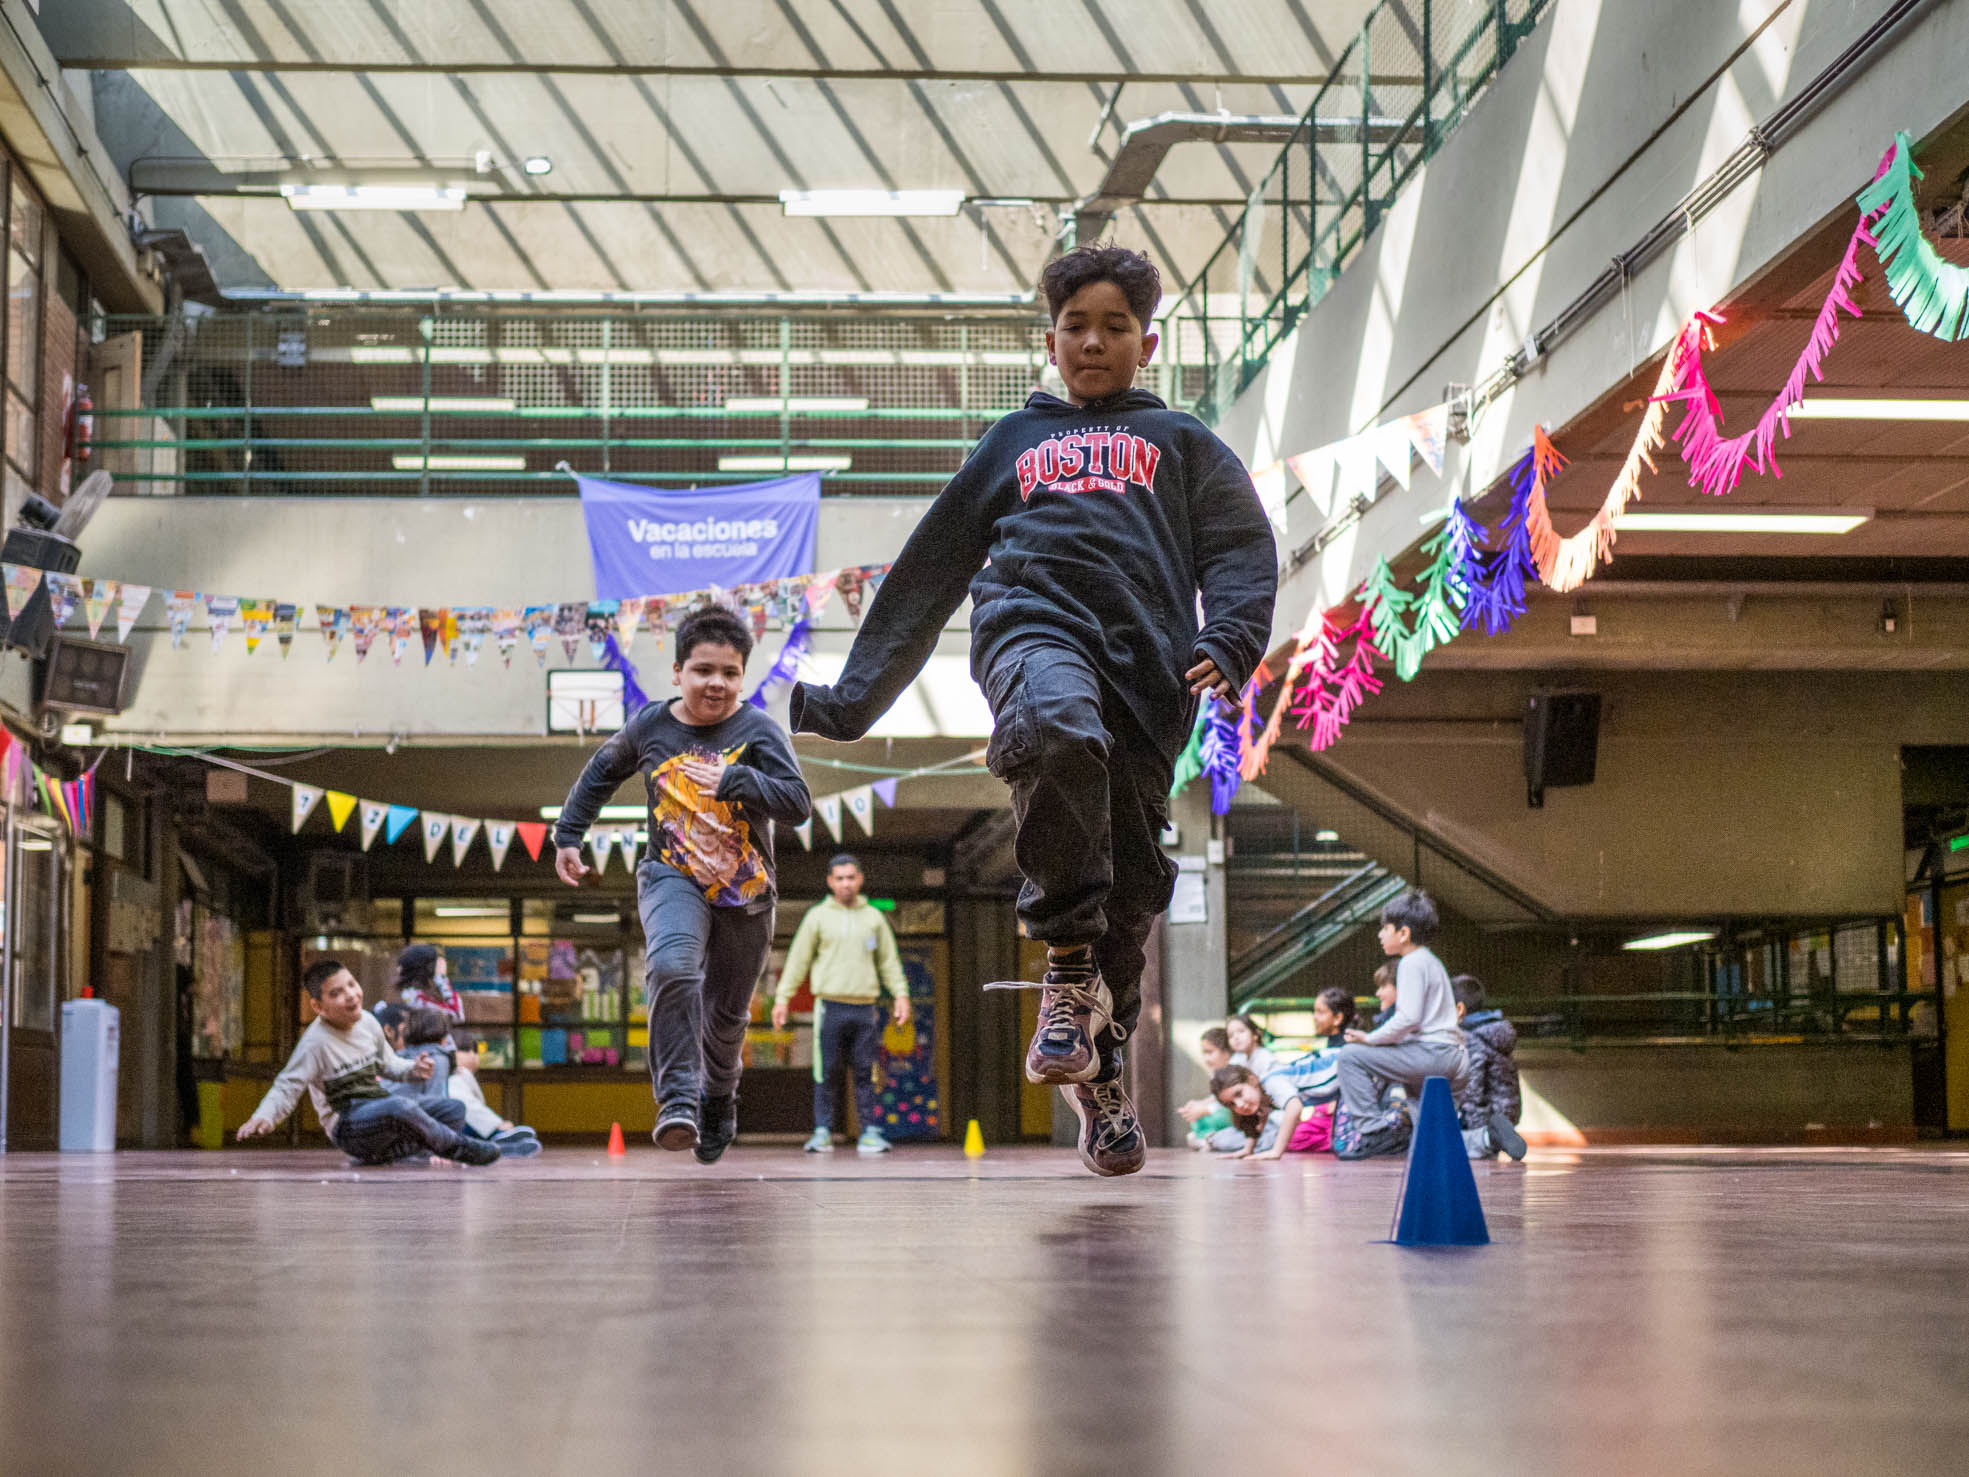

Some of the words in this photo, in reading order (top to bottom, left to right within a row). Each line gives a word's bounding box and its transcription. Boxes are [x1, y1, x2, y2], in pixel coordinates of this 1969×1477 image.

[1015, 432, 1161, 503] BOSTON
[1049, 480, 1085, 492] BLACK
[1088, 478, 1096, 489] &
[628, 516, 778, 543] Vacaciones
[650, 545, 671, 560] en
[674, 543, 691, 559] la
[692, 541, 758, 559] escuela
